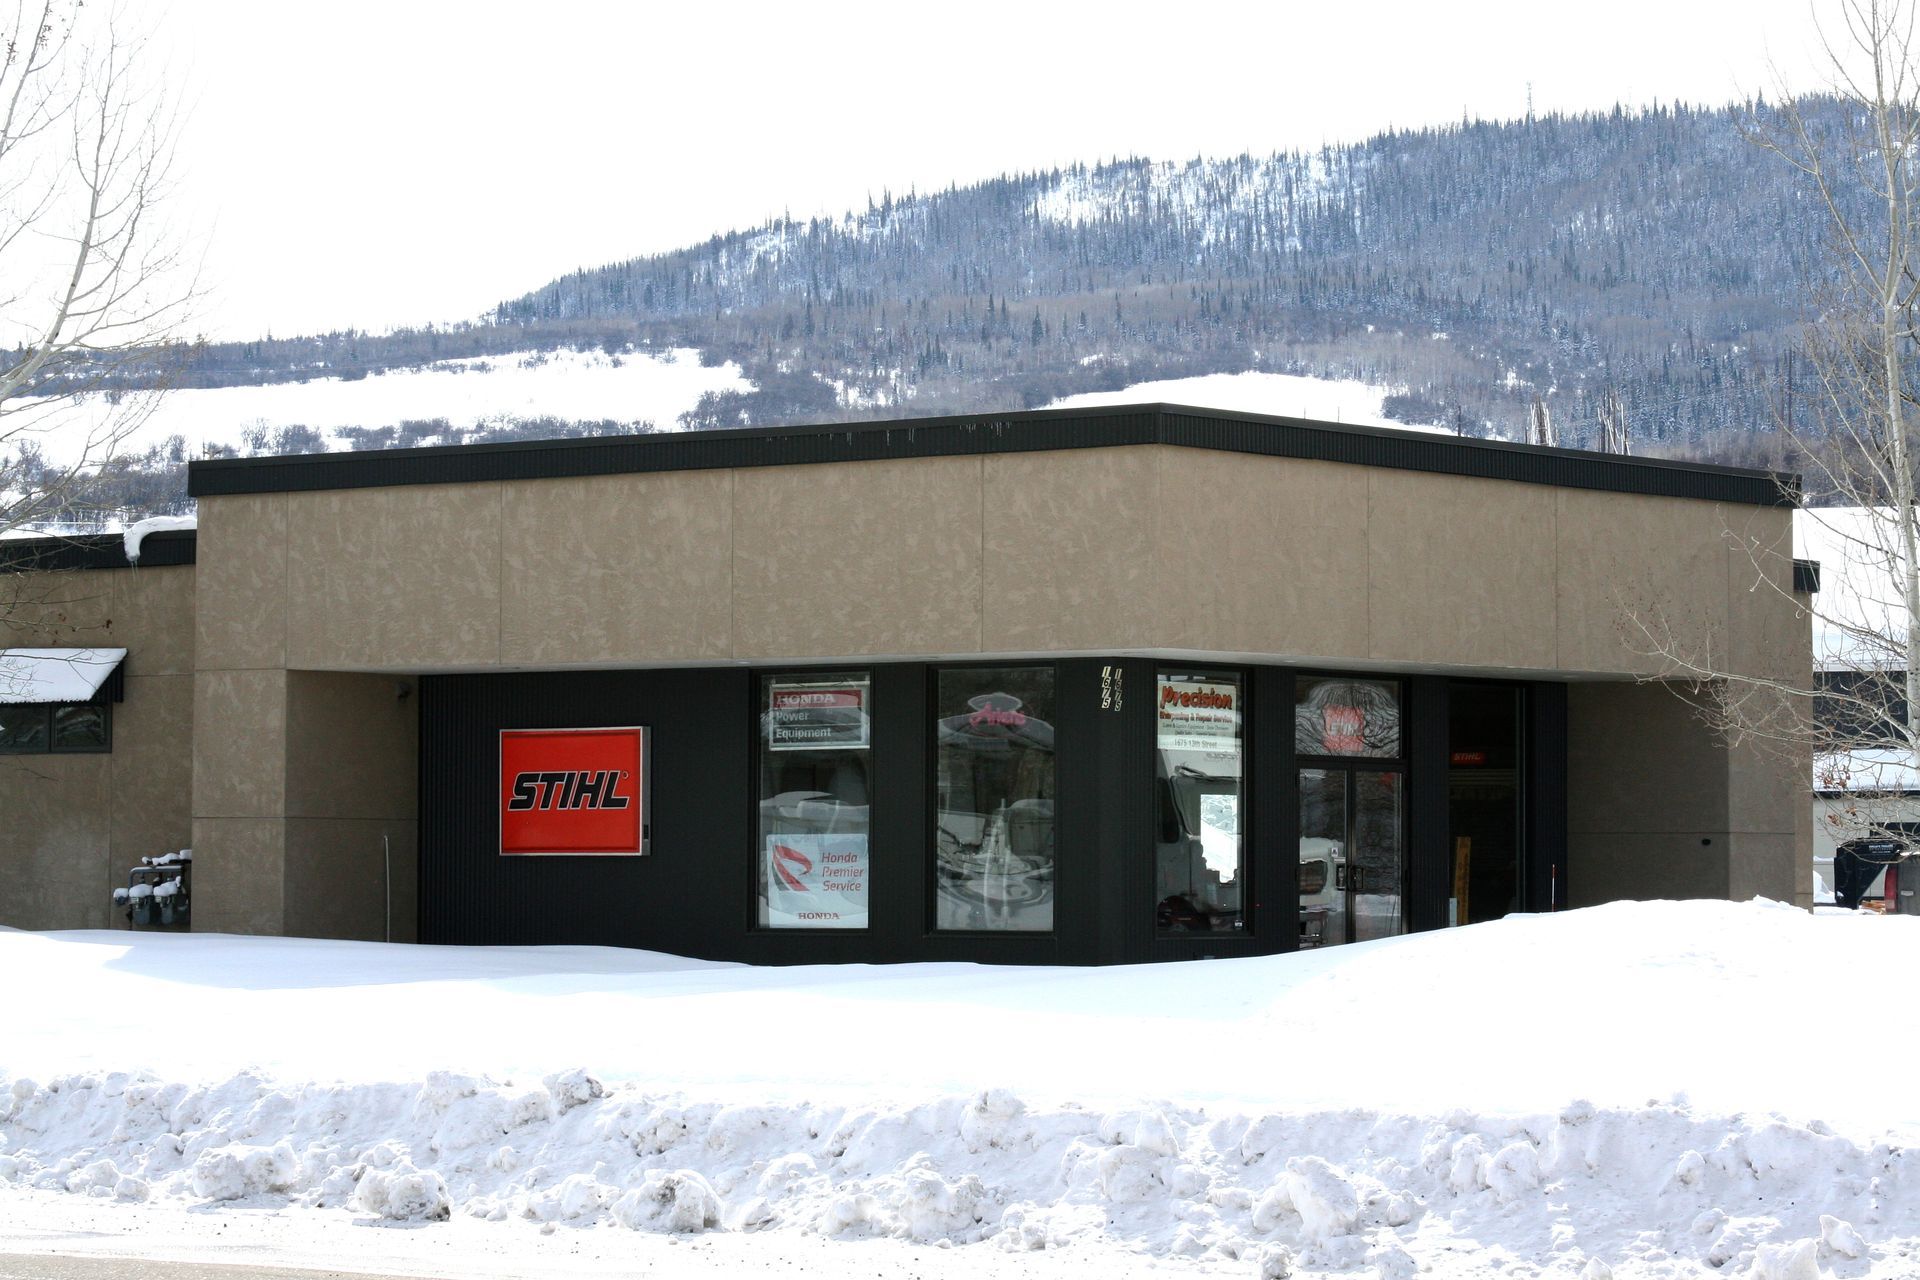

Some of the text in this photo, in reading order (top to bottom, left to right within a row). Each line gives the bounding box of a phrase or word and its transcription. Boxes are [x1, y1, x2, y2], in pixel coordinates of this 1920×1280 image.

[1102, 666, 1111, 708] 1675
[776, 693, 836, 705] HONDA
[776, 711, 810, 721] Power
[776, 727, 832, 739] Equipment
[1454, 752, 1481, 760] STIHL
[508, 770, 630, 811] STIHL
[821, 852, 858, 863] Honda
[822, 866, 865, 877] Premier
[823, 880, 862, 891] Service
[798, 912, 840, 920] HONDA
